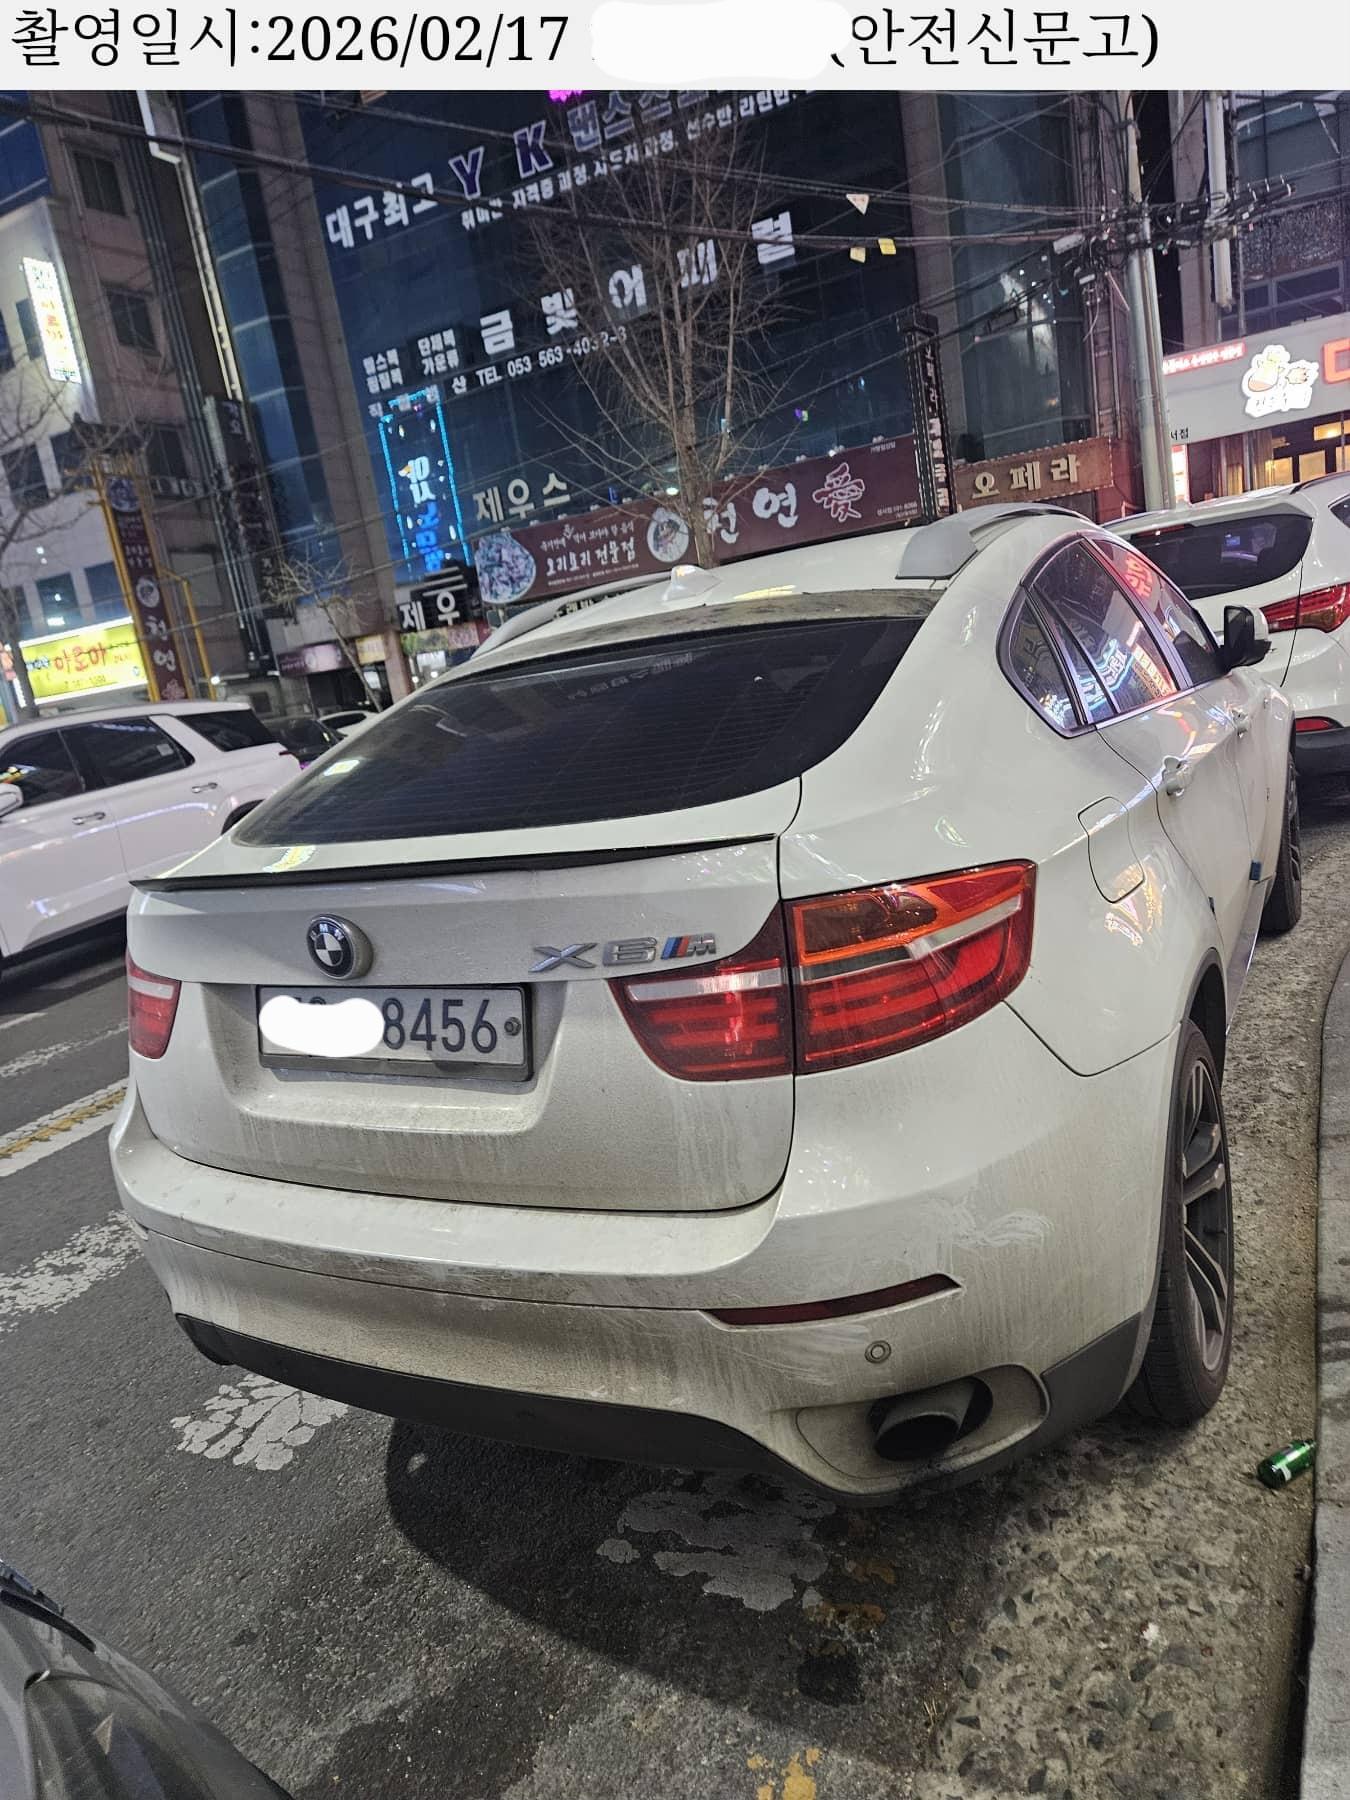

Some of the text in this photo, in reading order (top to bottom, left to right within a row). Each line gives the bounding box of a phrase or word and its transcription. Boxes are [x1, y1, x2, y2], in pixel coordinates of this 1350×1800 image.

[325, 172, 438, 248] 대구최고
[476, 366, 502, 388] TEL
[507, 354, 532, 378] 053
[473, 472, 571, 523] 제우스
[972, 453, 1081, 499] 오페라
[383, 996, 498, 1053] 8456
